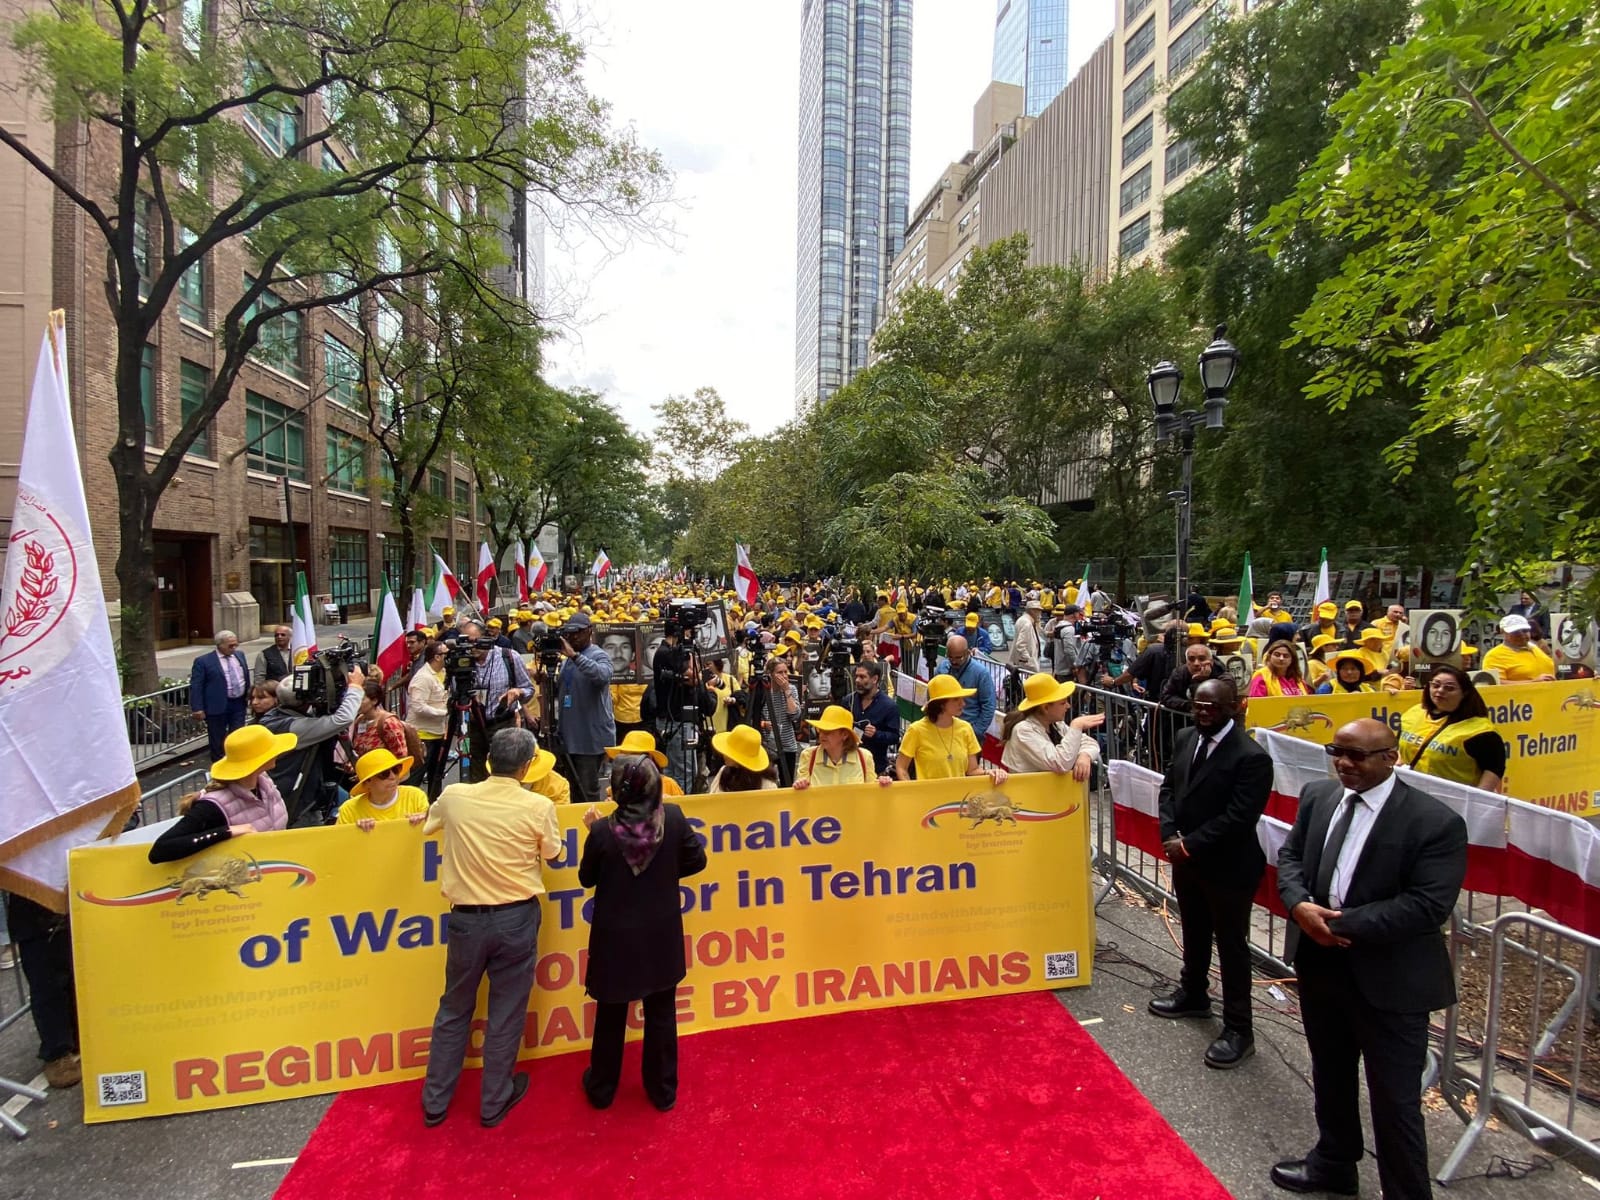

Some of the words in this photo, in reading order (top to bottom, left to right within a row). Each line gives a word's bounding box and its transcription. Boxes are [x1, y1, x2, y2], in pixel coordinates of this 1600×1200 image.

[1371, 706, 1402, 731] He
[1487, 699, 1533, 724] nake
[1401, 731, 1424, 746] REE
[1428, 740, 1459, 757] RAN
[1517, 732, 1577, 758] Tehran
[239, 918, 310, 969] of
[738, 870, 785, 908] in
[801, 861, 977, 901] Tehran
[172, 1027, 433, 1100] REGIME
[713, 975, 781, 1019] BY
[795, 951, 1032, 1008] IRANIANS
